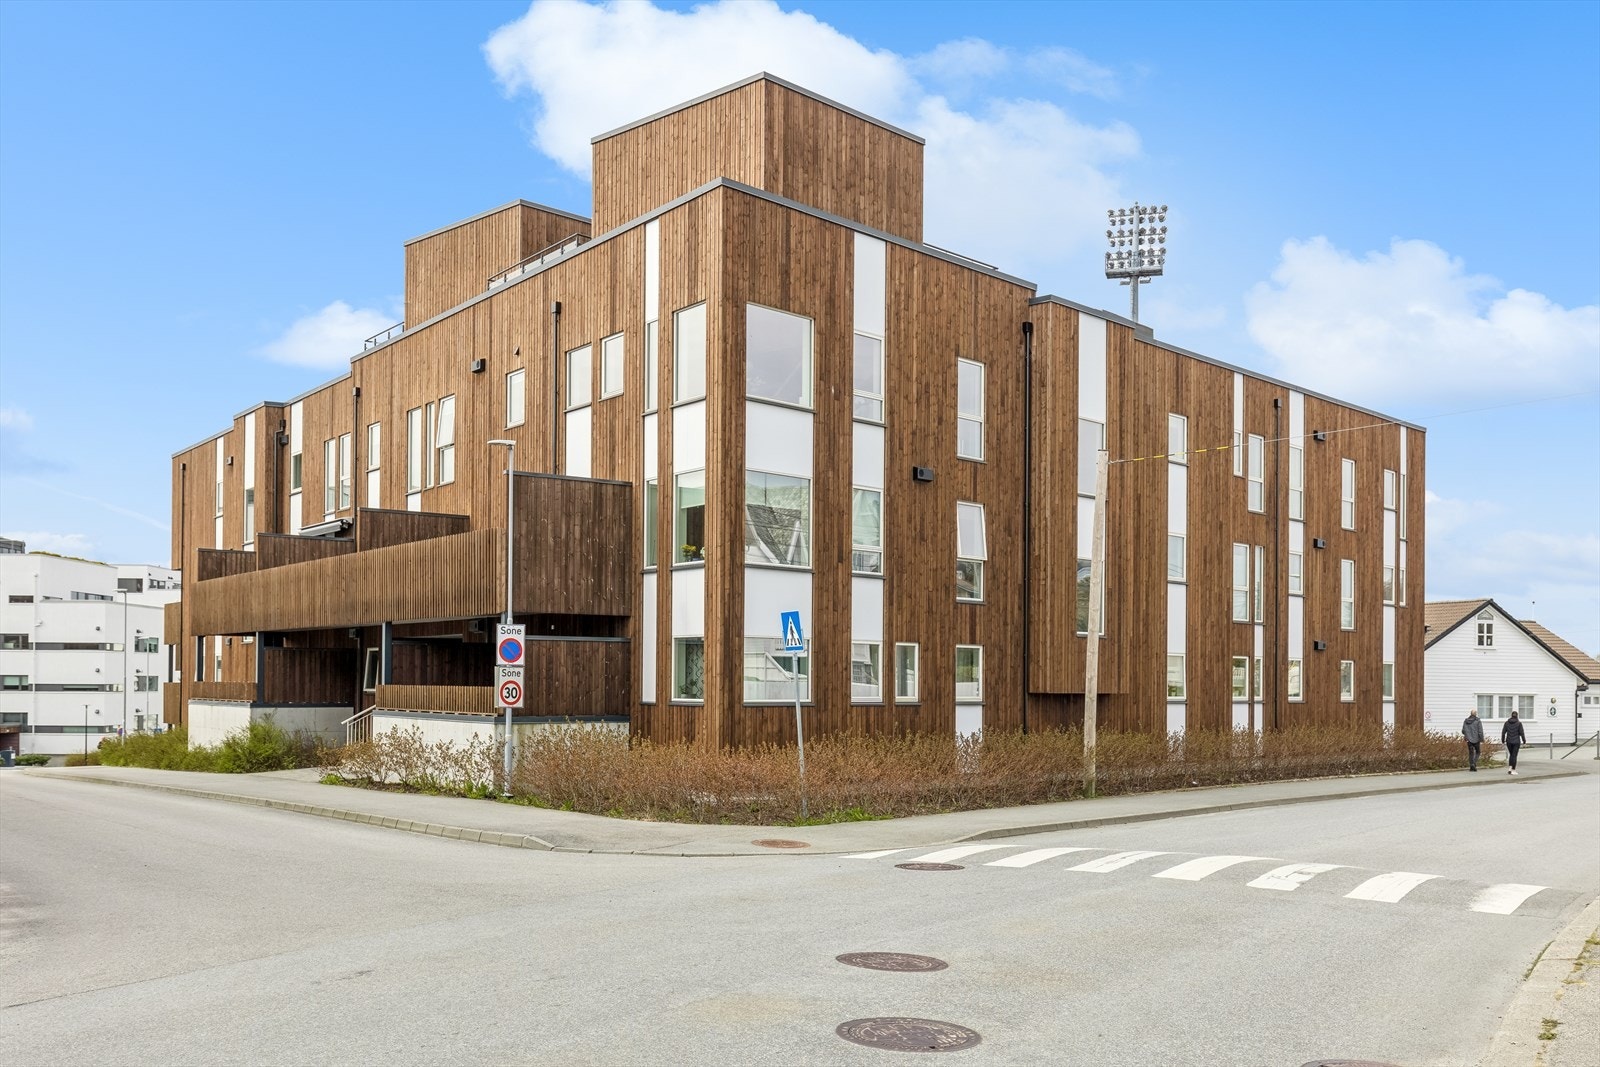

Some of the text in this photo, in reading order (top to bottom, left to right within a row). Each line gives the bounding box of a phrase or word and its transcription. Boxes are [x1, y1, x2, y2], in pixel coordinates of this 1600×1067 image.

[500, 626, 522, 635] Sone
[501, 668, 521, 677] Sone
[504, 686, 518, 699] 30
